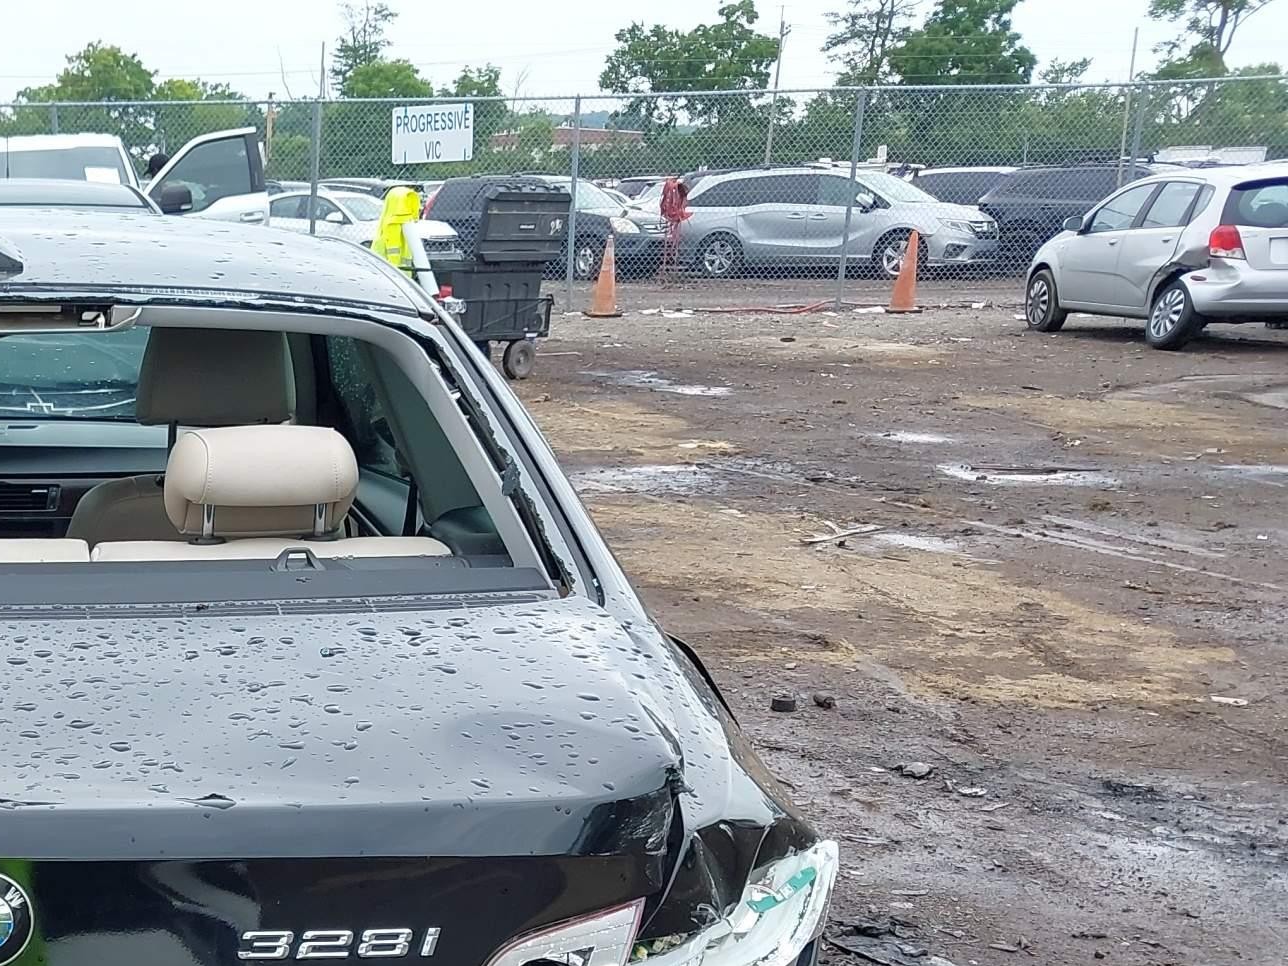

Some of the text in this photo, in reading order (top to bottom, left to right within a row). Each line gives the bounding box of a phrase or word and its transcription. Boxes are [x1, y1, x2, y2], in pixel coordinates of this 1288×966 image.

[396, 110, 470, 135] PROGRESSIVE
[424, 140, 442, 160] VIC
[237, 927, 442, 960] 328i
